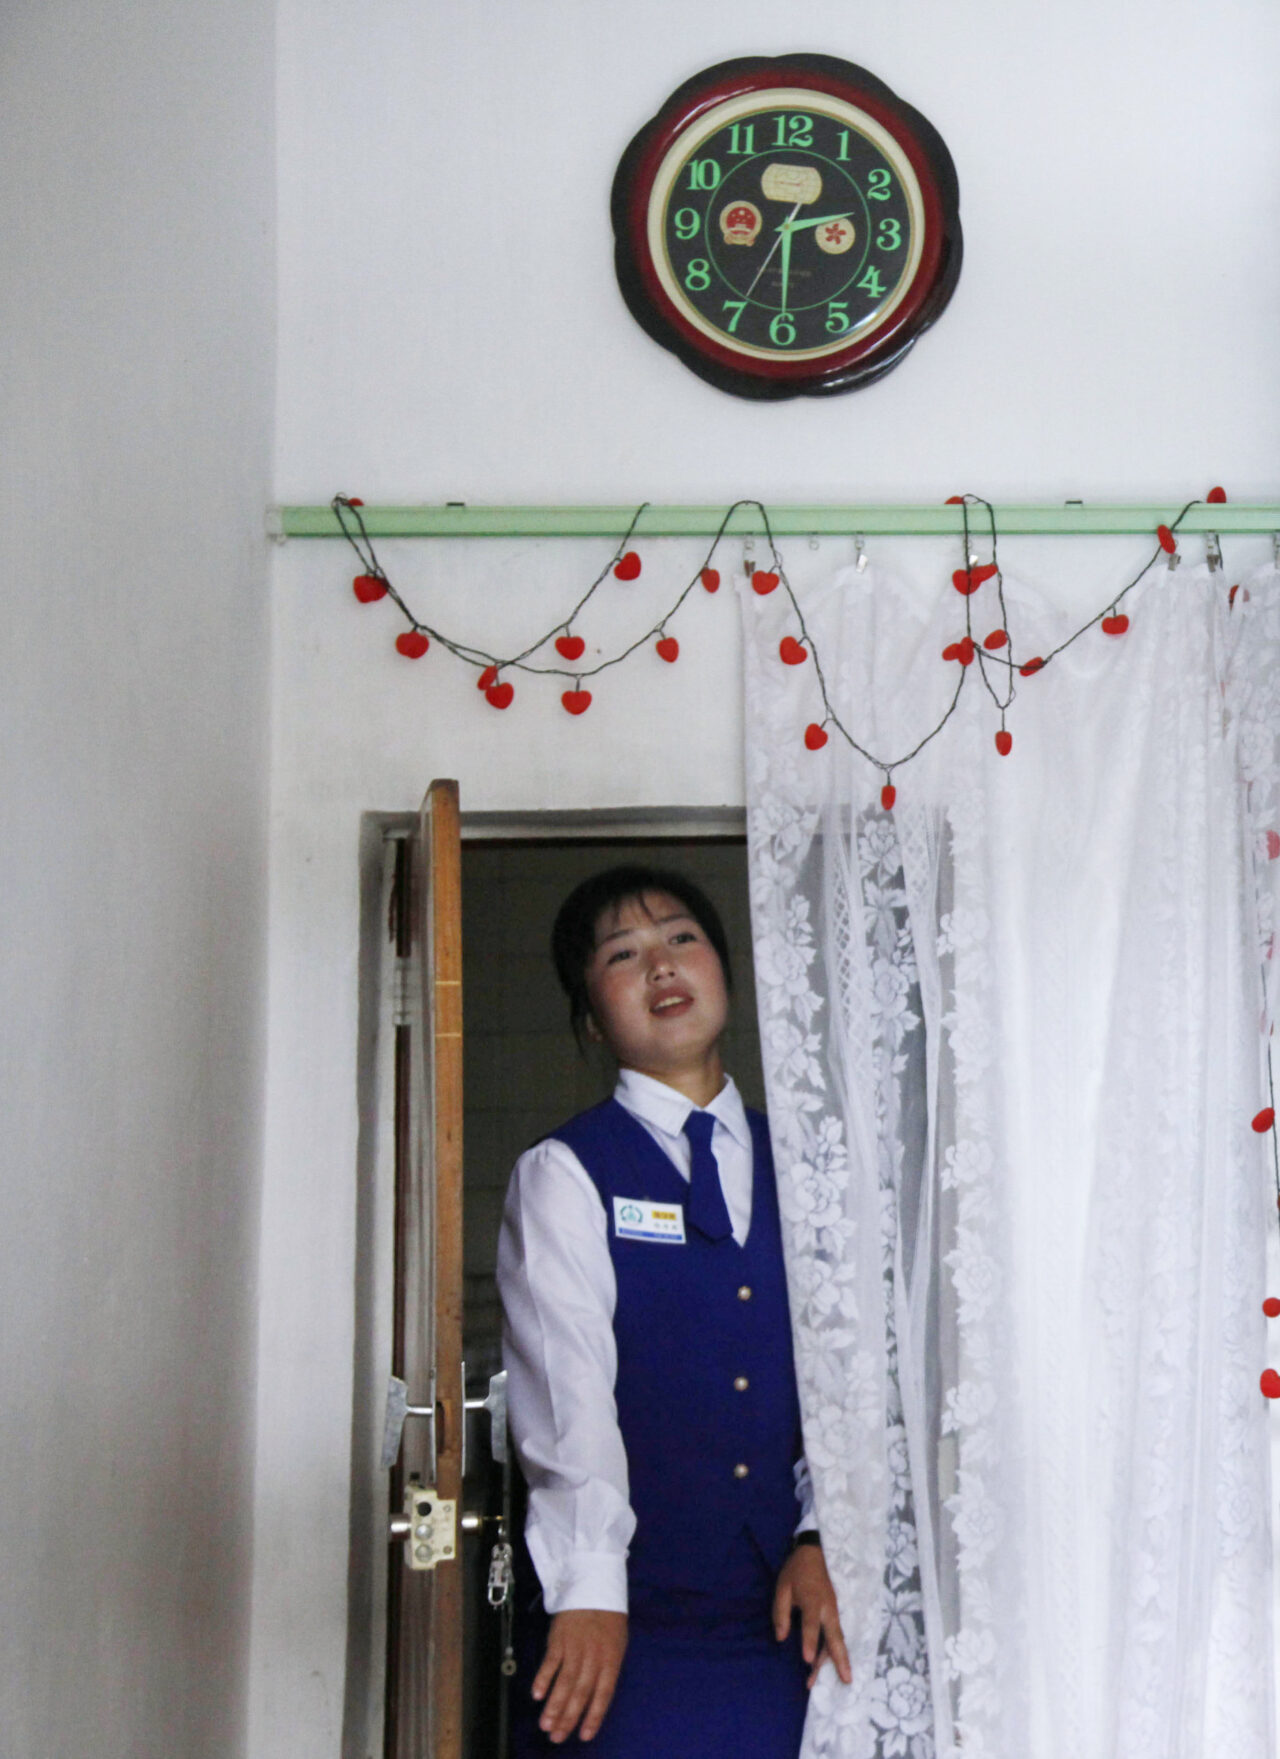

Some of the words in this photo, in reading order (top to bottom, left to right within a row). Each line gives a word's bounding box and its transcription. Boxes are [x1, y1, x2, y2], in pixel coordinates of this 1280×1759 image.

[727, 123, 756, 155] 11
[771, 115, 814, 148] 12
[836, 130, 851, 161] 1
[687, 158, 722, 190] 10
[866, 168, 892, 201] 2
[674, 207, 701, 240] 9
[876, 218, 902, 251] 3
[684, 258, 711, 291] 8
[856, 265, 887, 298] 4
[722, 300, 748, 333] 7
[768, 312, 798, 346] 6
[825, 301, 850, 334] 5
